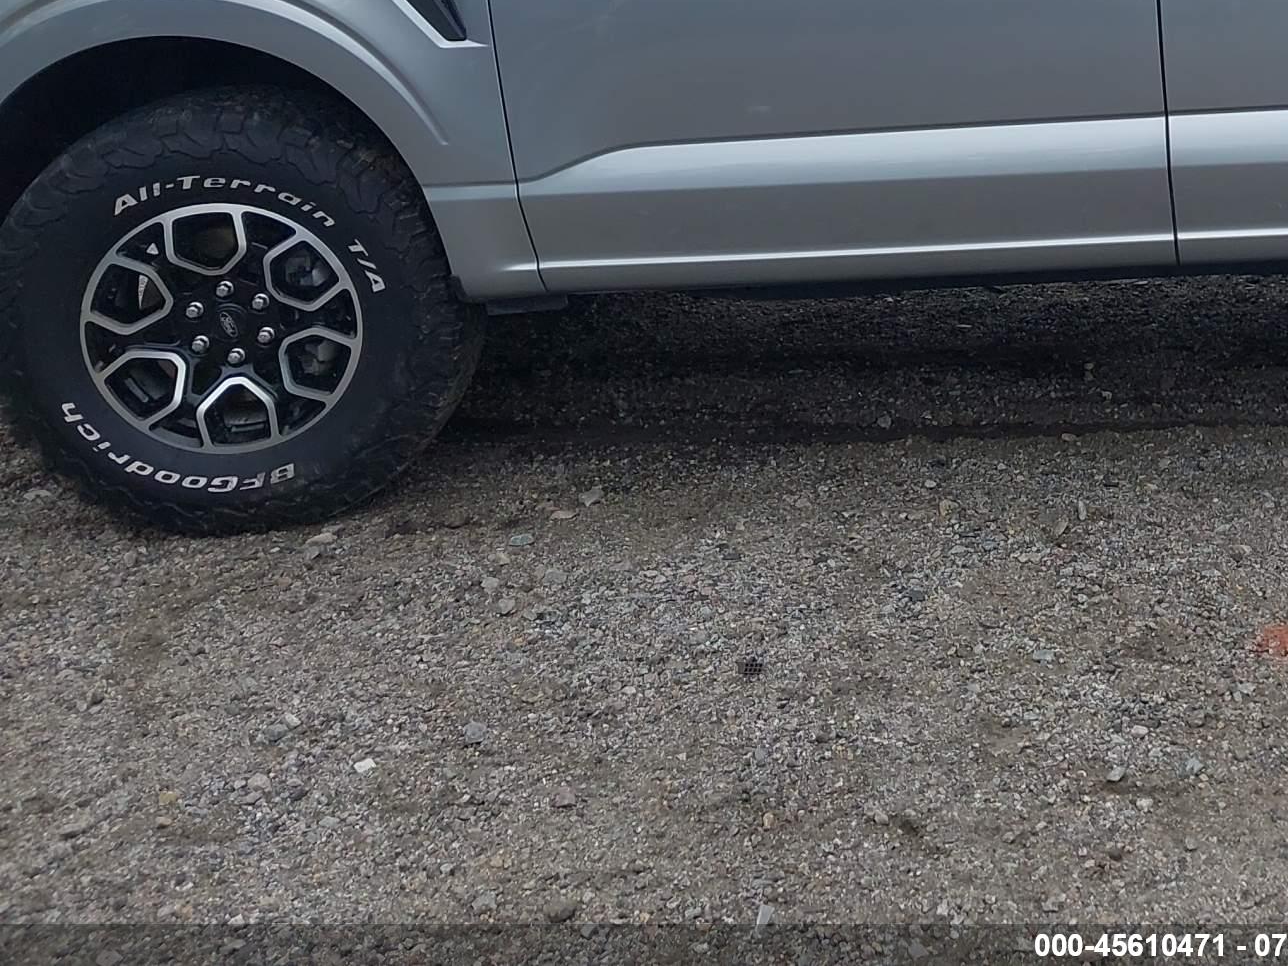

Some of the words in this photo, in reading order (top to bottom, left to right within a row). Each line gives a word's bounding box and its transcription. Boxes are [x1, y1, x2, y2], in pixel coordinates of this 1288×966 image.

[113, 174, 336, 228] All-Terrain
[346, 238, 387, 293] T/A
[61, 402, 295, 493] BFGoodrich
